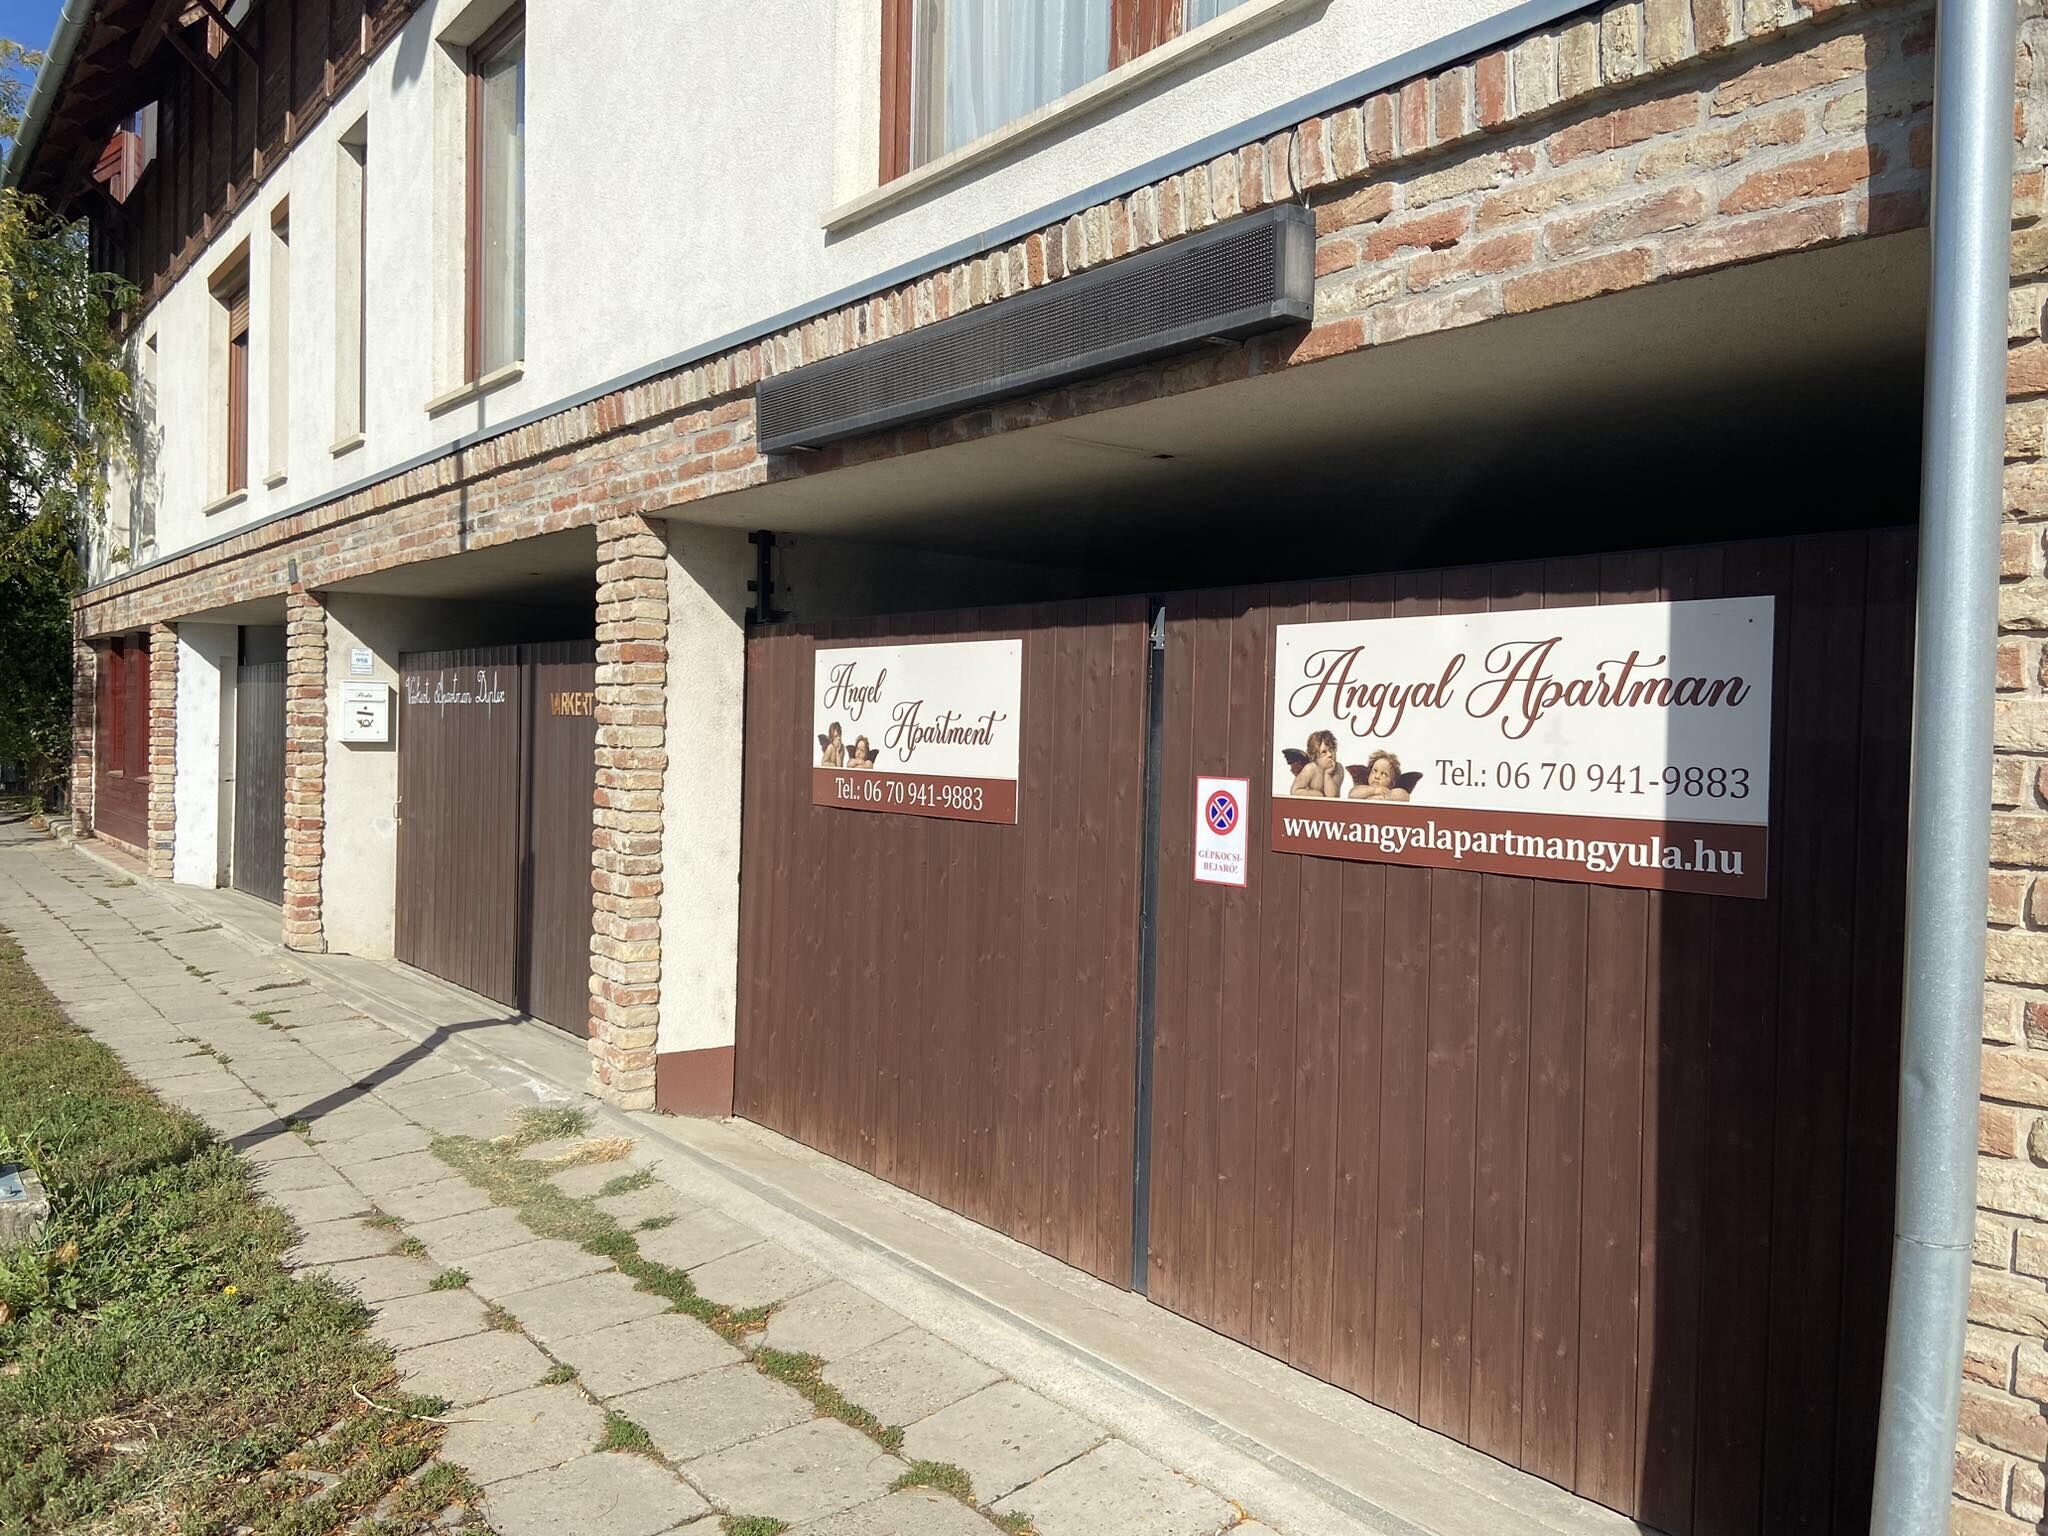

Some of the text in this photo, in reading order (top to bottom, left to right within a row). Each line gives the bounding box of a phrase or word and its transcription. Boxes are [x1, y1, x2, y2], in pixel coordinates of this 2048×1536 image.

[823, 661, 887, 722] Angel
[1288, 636, 1751, 740] Angyal Apartman
[884, 699, 1007, 763] Apartment
[835, 777, 984, 811] Tel.: 06 70 941-9883
[1435, 759, 1751, 799] Tel.: 06 70 941-9883
[1283, 816, 1744, 876] www.angyalapartmangyula.hu
